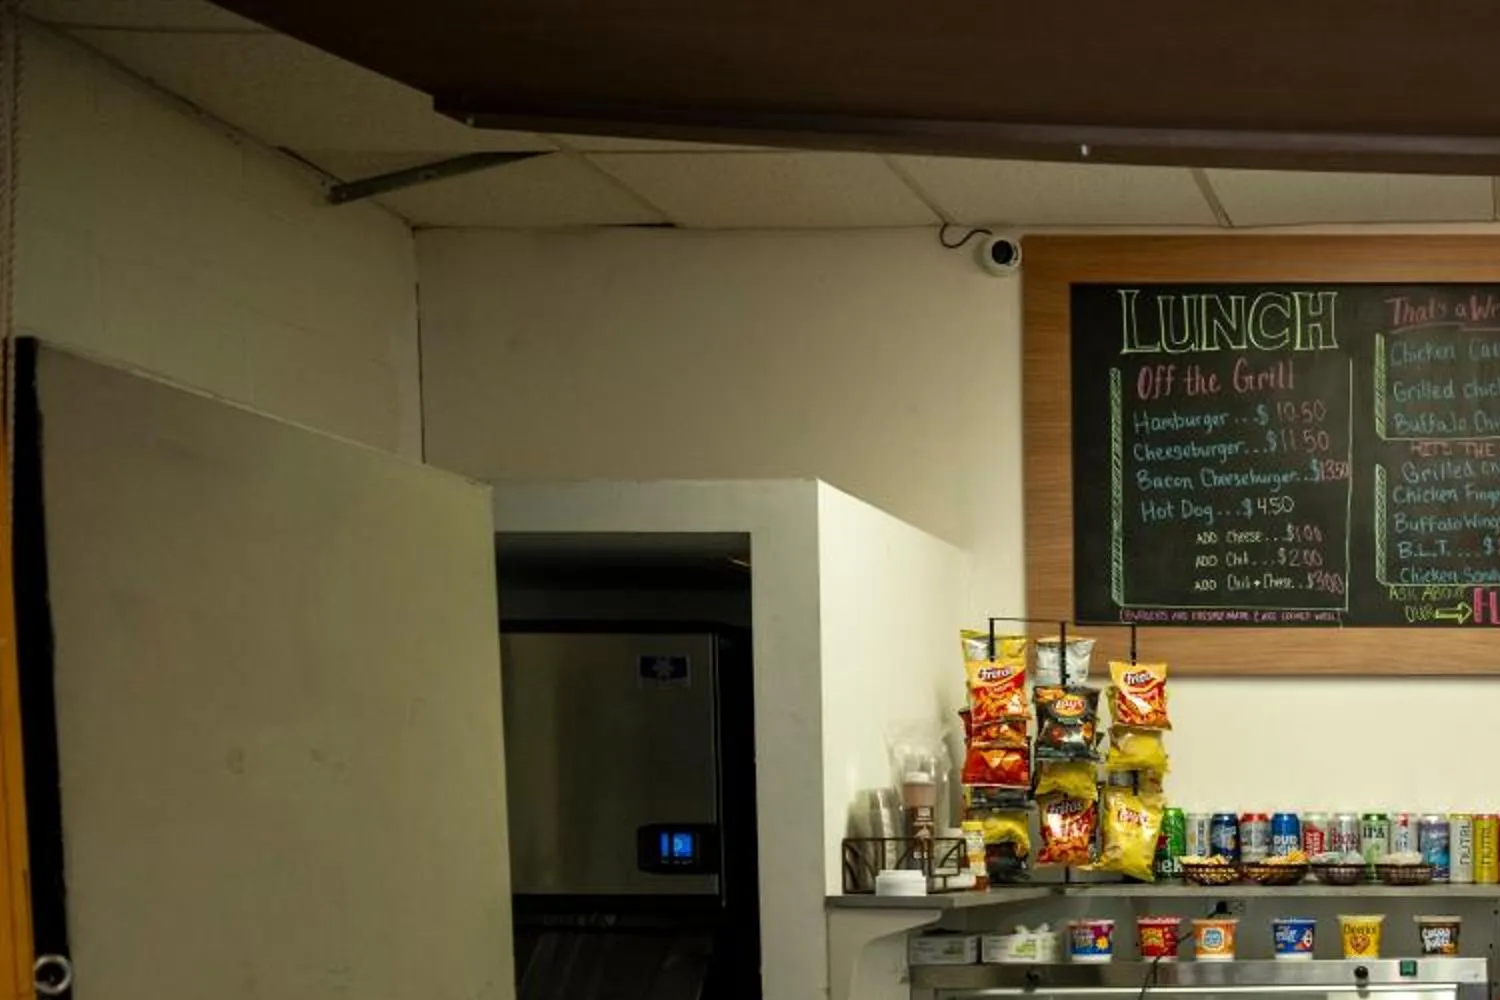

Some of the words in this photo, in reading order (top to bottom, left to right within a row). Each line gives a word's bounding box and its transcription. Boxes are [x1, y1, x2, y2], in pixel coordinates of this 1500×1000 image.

[1118, 289, 1339, 354] LUNCH
[1384, 297, 1447, 326] That's
[1137, 365, 1174, 400] Off
[1184, 365, 1220, 395] the
[1233, 356, 1295, 393] Grill
[1393, 380, 1455, 402] Grilled
[1133, 409, 1229, 435] Hamburger
[1393, 413, 1466, 435] Buffalo
[1134, 438, 1245, 464] Cheeseburger
[1464, 440, 1495, 458] THE
[1136, 470, 1193, 491] Bacon
[1401, 460, 1472, 484] Grilled
[1392, 486, 1458, 503] Chicken
[1141, 502, 1175, 522] Hot
[1181, 501, 1214, 525] Dog
